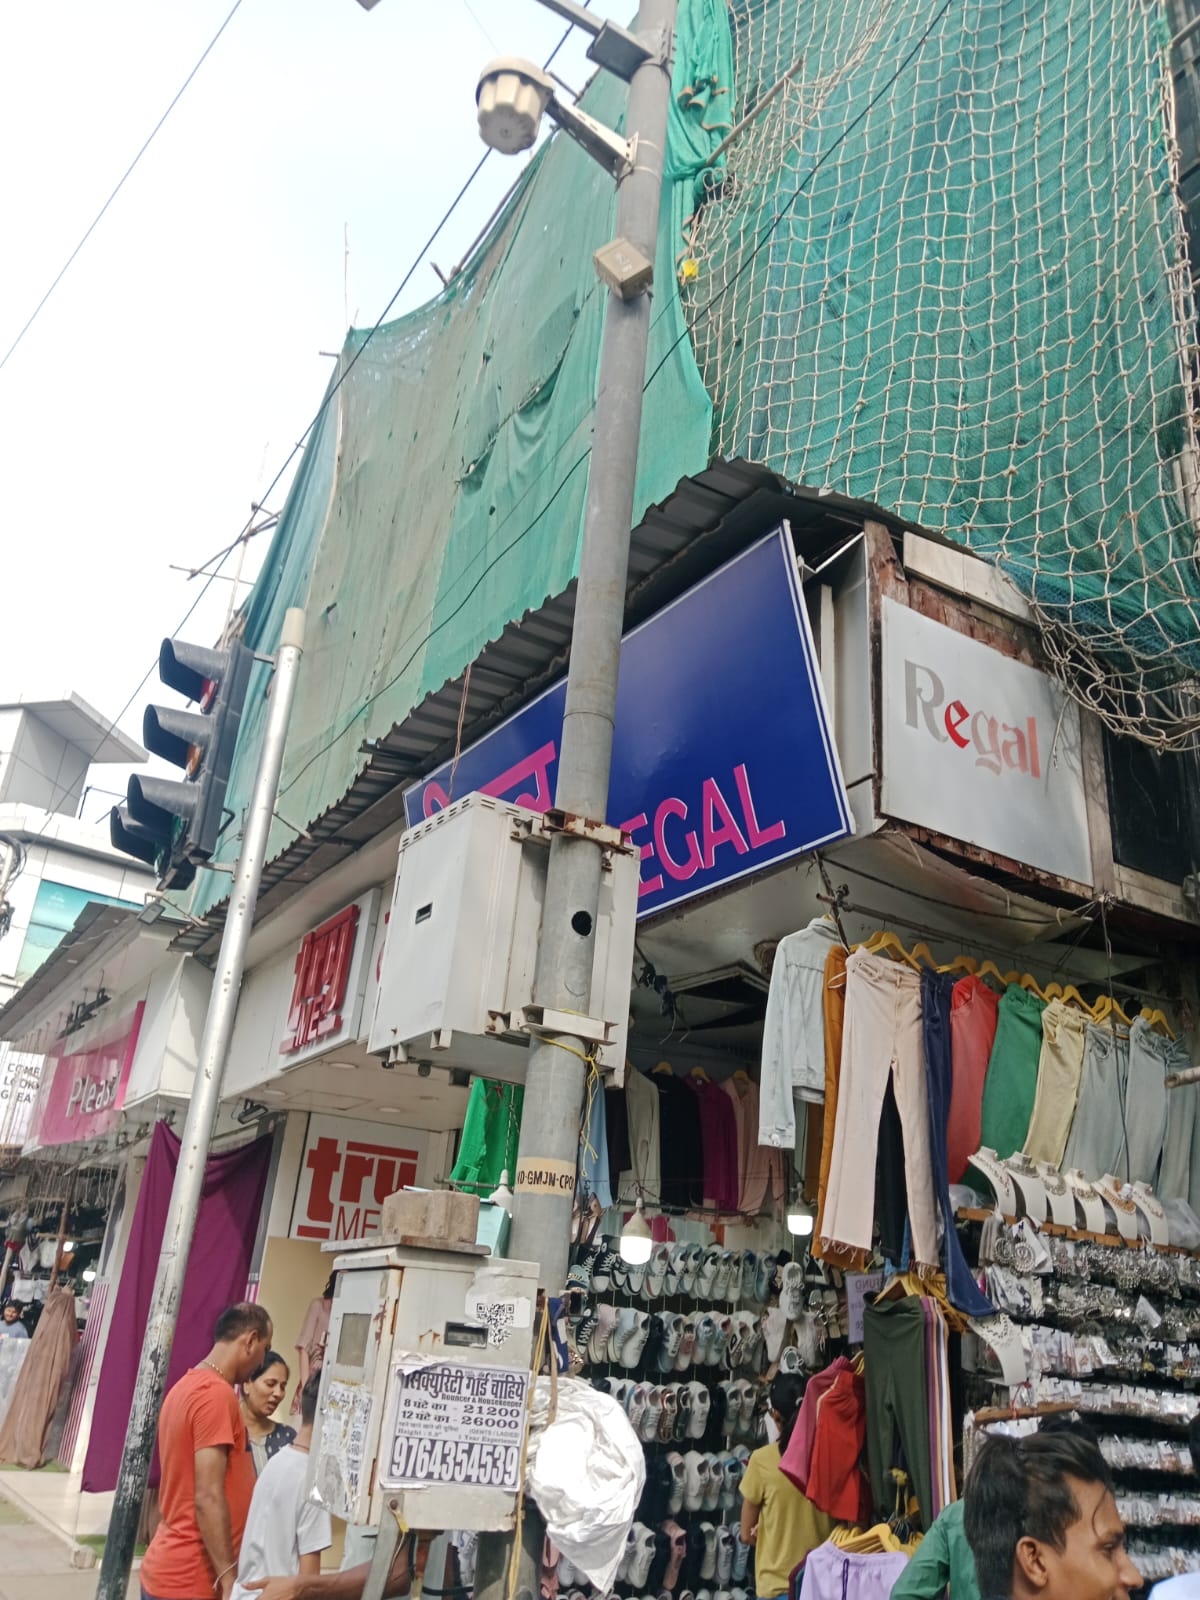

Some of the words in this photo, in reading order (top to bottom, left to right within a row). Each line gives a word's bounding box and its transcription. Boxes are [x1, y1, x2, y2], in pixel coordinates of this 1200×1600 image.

[904, 659, 1041, 779] Regal
[620, 763, 786, 898] EGAL
[401, 1410, 413, 1419] 12
[461, 1415, 519, 1430] 26000
[404, 1399, 411, 1408] 8
[463, 1404, 520, 1418] 21200
[391, 1437, 518, 1485] 9764354539
